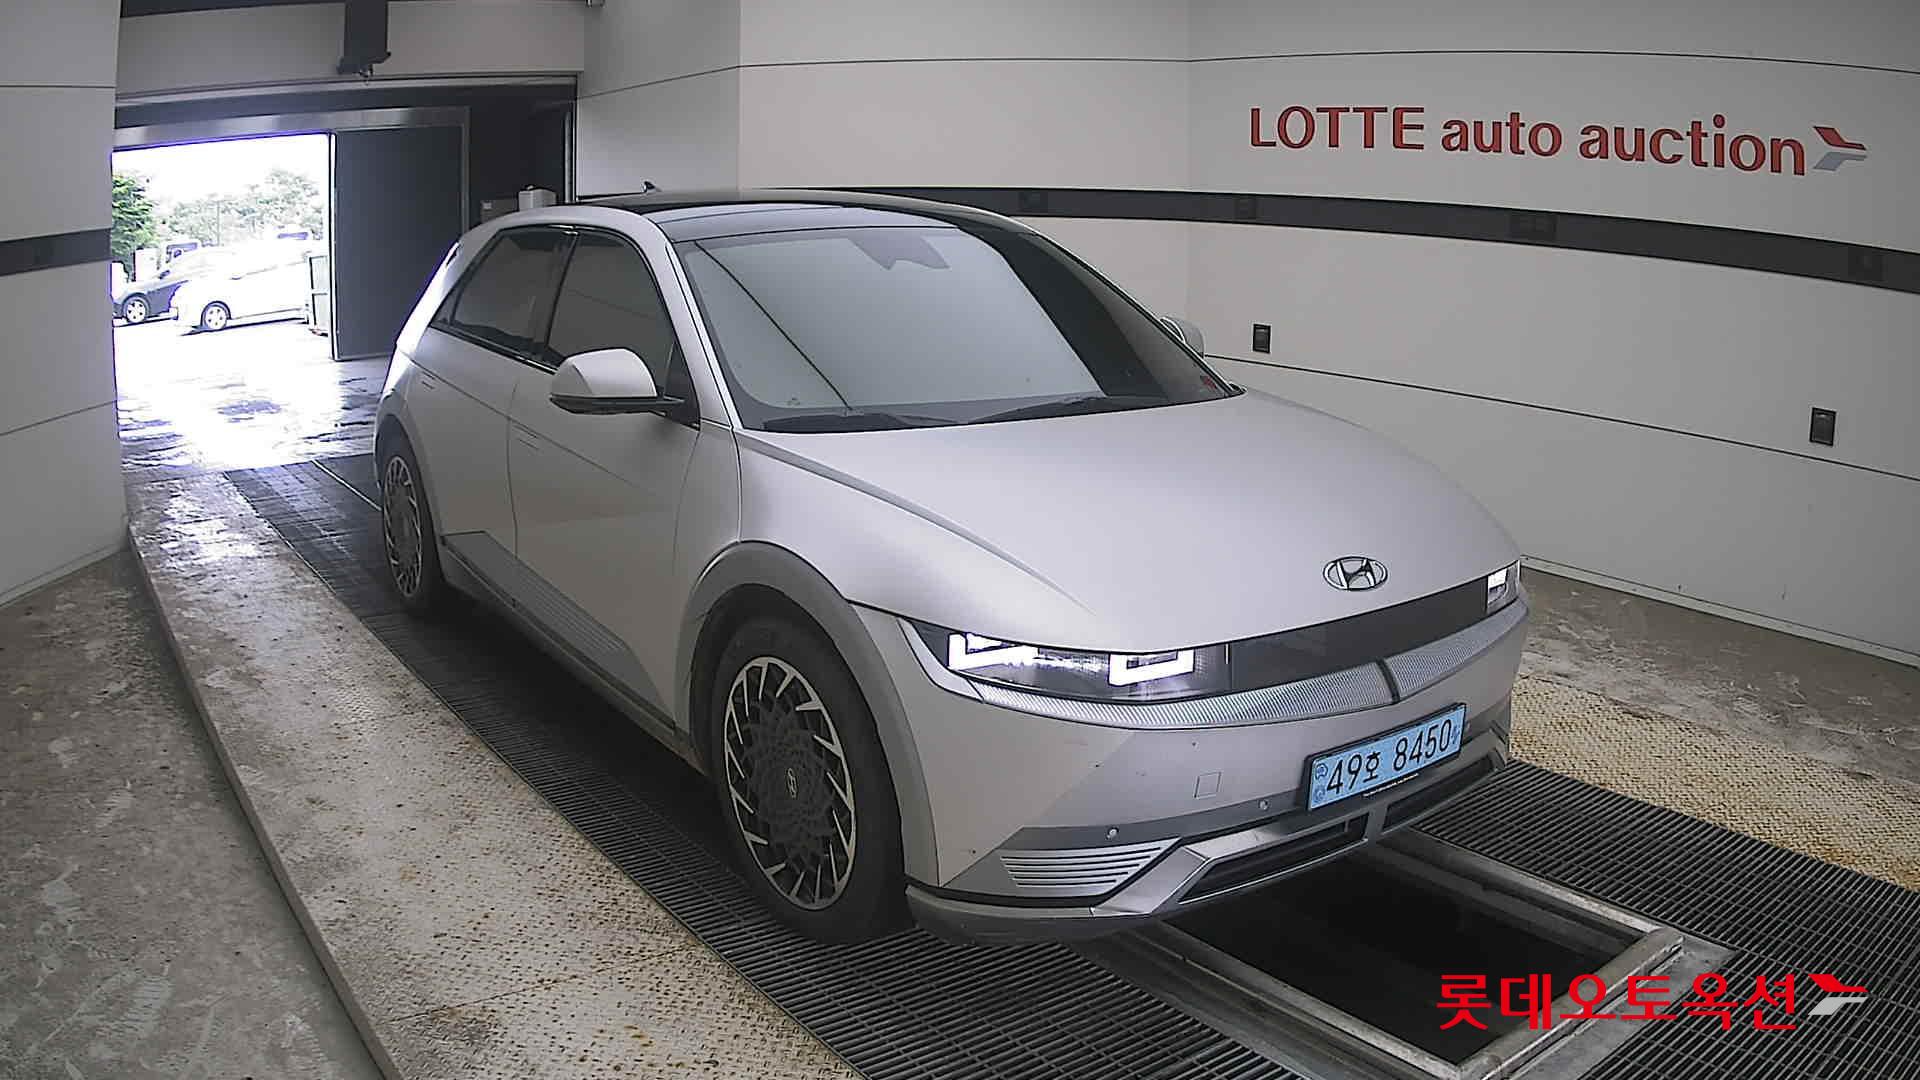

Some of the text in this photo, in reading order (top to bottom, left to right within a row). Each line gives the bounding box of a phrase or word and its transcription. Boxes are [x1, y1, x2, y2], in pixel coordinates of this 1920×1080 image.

[1250, 106, 1805, 176] LOTTE auto auction
[1327, 719, 1452, 795] 49호 8450
